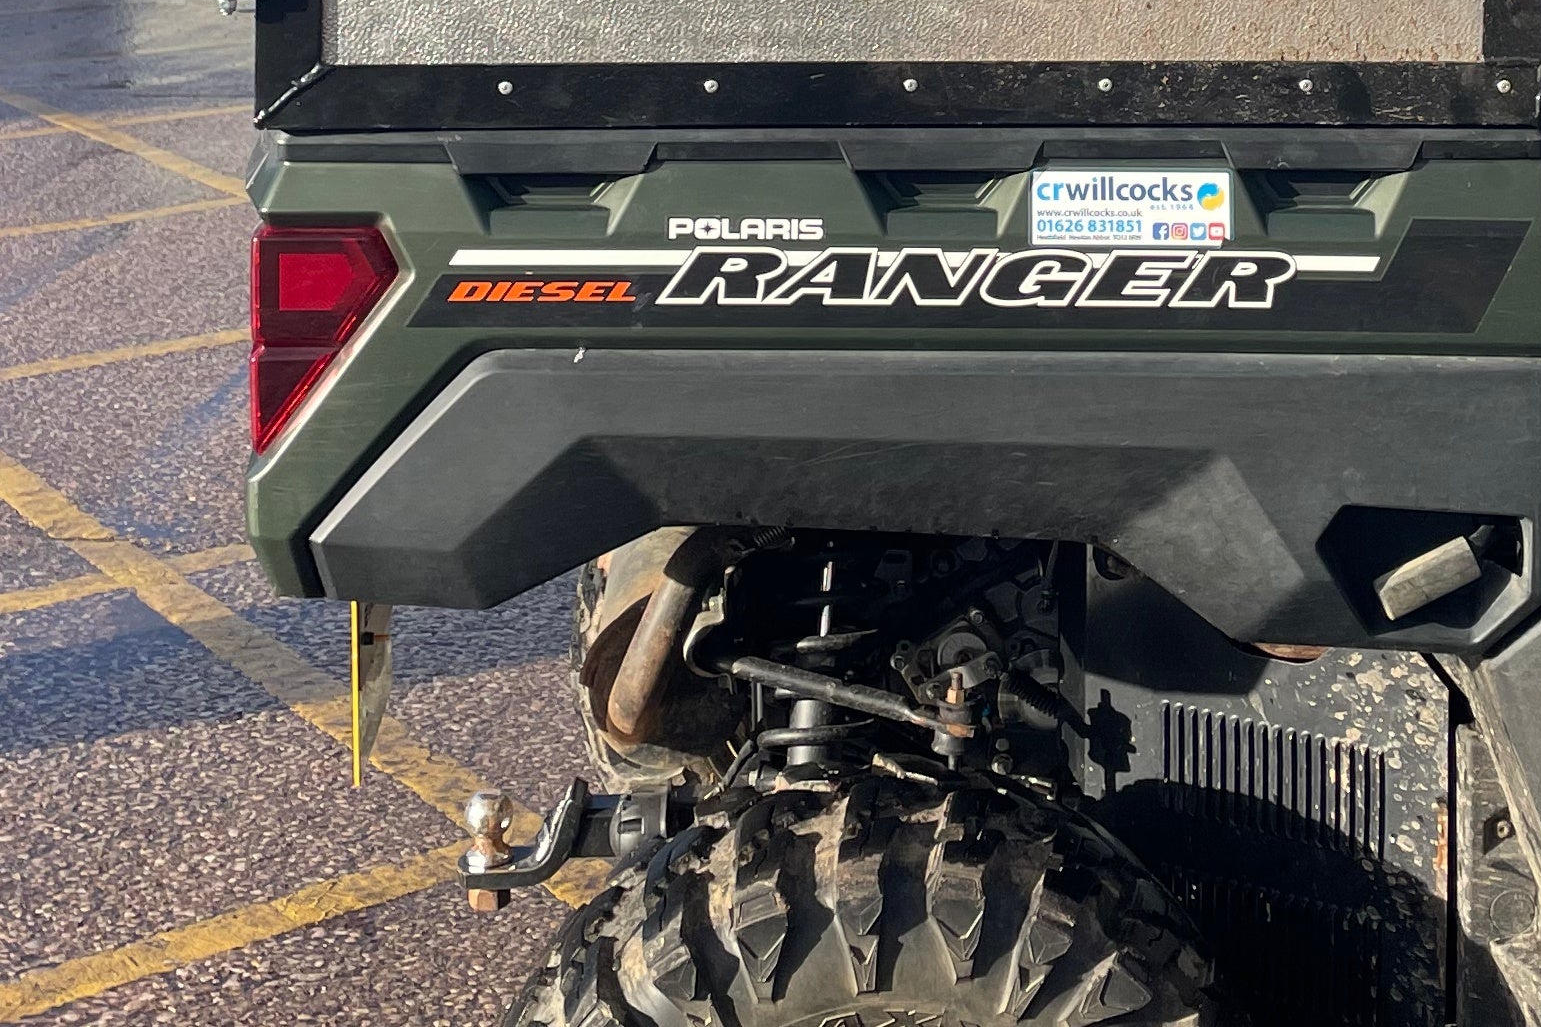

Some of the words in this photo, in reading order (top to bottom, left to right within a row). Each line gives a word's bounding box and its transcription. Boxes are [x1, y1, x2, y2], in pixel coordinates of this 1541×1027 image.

[1036, 176, 1193, 201] crwillcocks
[1037, 208, 1143, 217] www.crwillcocks.co.uk
[668, 217, 824, 240] POLARIS
[1037, 219, 1083, 232] 01626
[1088, 219, 1142, 232] 831851
[655, 246, 1300, 309] RANGER
[447, 281, 638, 303] DIESEL
